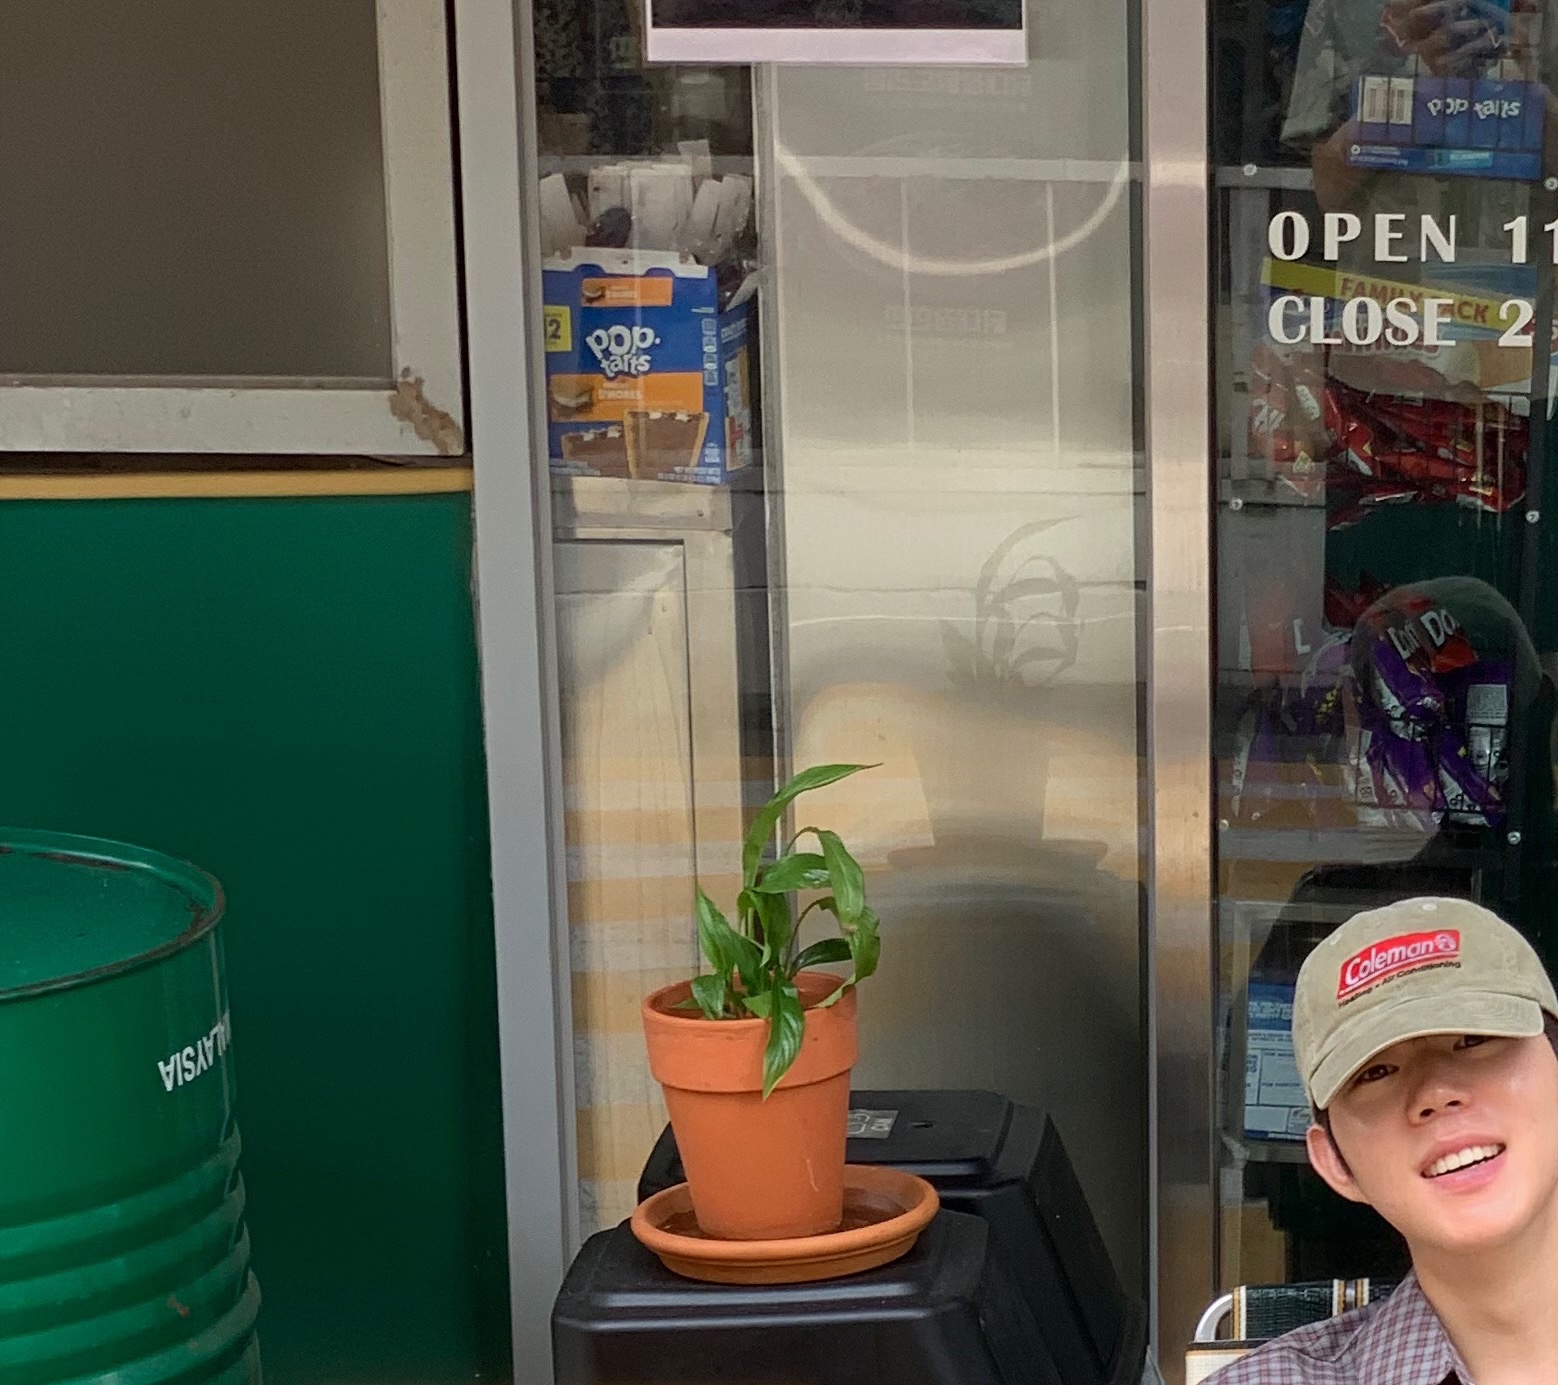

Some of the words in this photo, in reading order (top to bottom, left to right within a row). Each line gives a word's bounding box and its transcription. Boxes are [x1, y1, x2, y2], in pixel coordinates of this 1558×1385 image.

[1268, 211, 1457, 262] OPEN
[1268, 296, 1457, 347] CLOSE
[600, 355, 651, 377] tarts
[1344, 939, 1435, 985] Coleman
[1397, 961, 1461, 977] Conditioning
